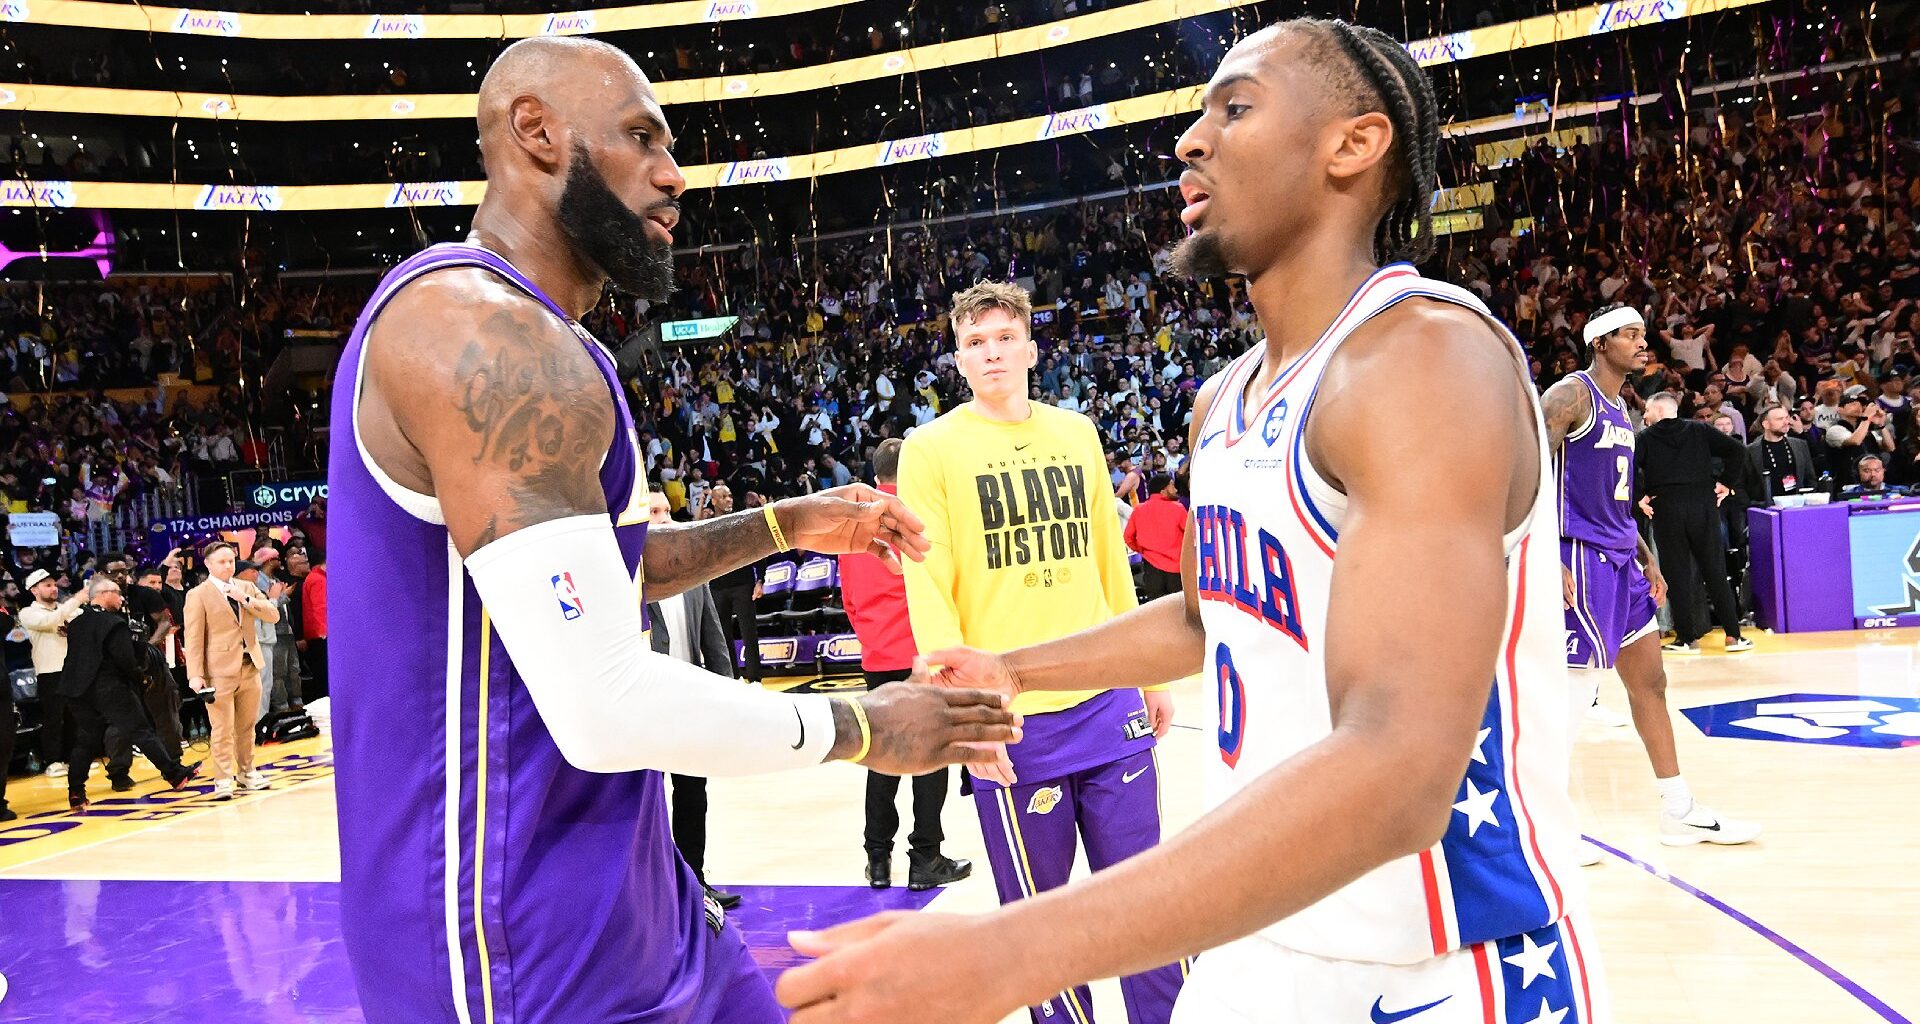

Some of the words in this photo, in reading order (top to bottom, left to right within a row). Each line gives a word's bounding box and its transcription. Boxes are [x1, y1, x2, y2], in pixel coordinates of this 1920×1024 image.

[709, 2, 751, 18] LAKERS
[180, 13, 232, 32] LAKERS
[371, 18, 418, 34] LAKERS
[547, 16, 589, 33] LAKERS
[1044, 112, 1100, 137] LAKERS
[883, 139, 939, 162] LAKERS
[727, 161, 782, 183] LAKERS
[203, 184, 272, 210] LAKERS
[393, 182, 454, 206] LAKERS
[675, 325, 696, 336] UCLA
[987, 457, 1037, 469] BUILT
[1614, 455, 1630, 501] 2
[975, 464, 1089, 531] BLACK
[170, 520, 195, 533] 17x
[198, 510, 293, 531] CHAMPIONS
[984, 521, 1089, 569] HISTORY
[1195, 504, 1309, 654] HILA
[1863, 617, 1897, 628] anc
[1215, 641, 1247, 771] 0
